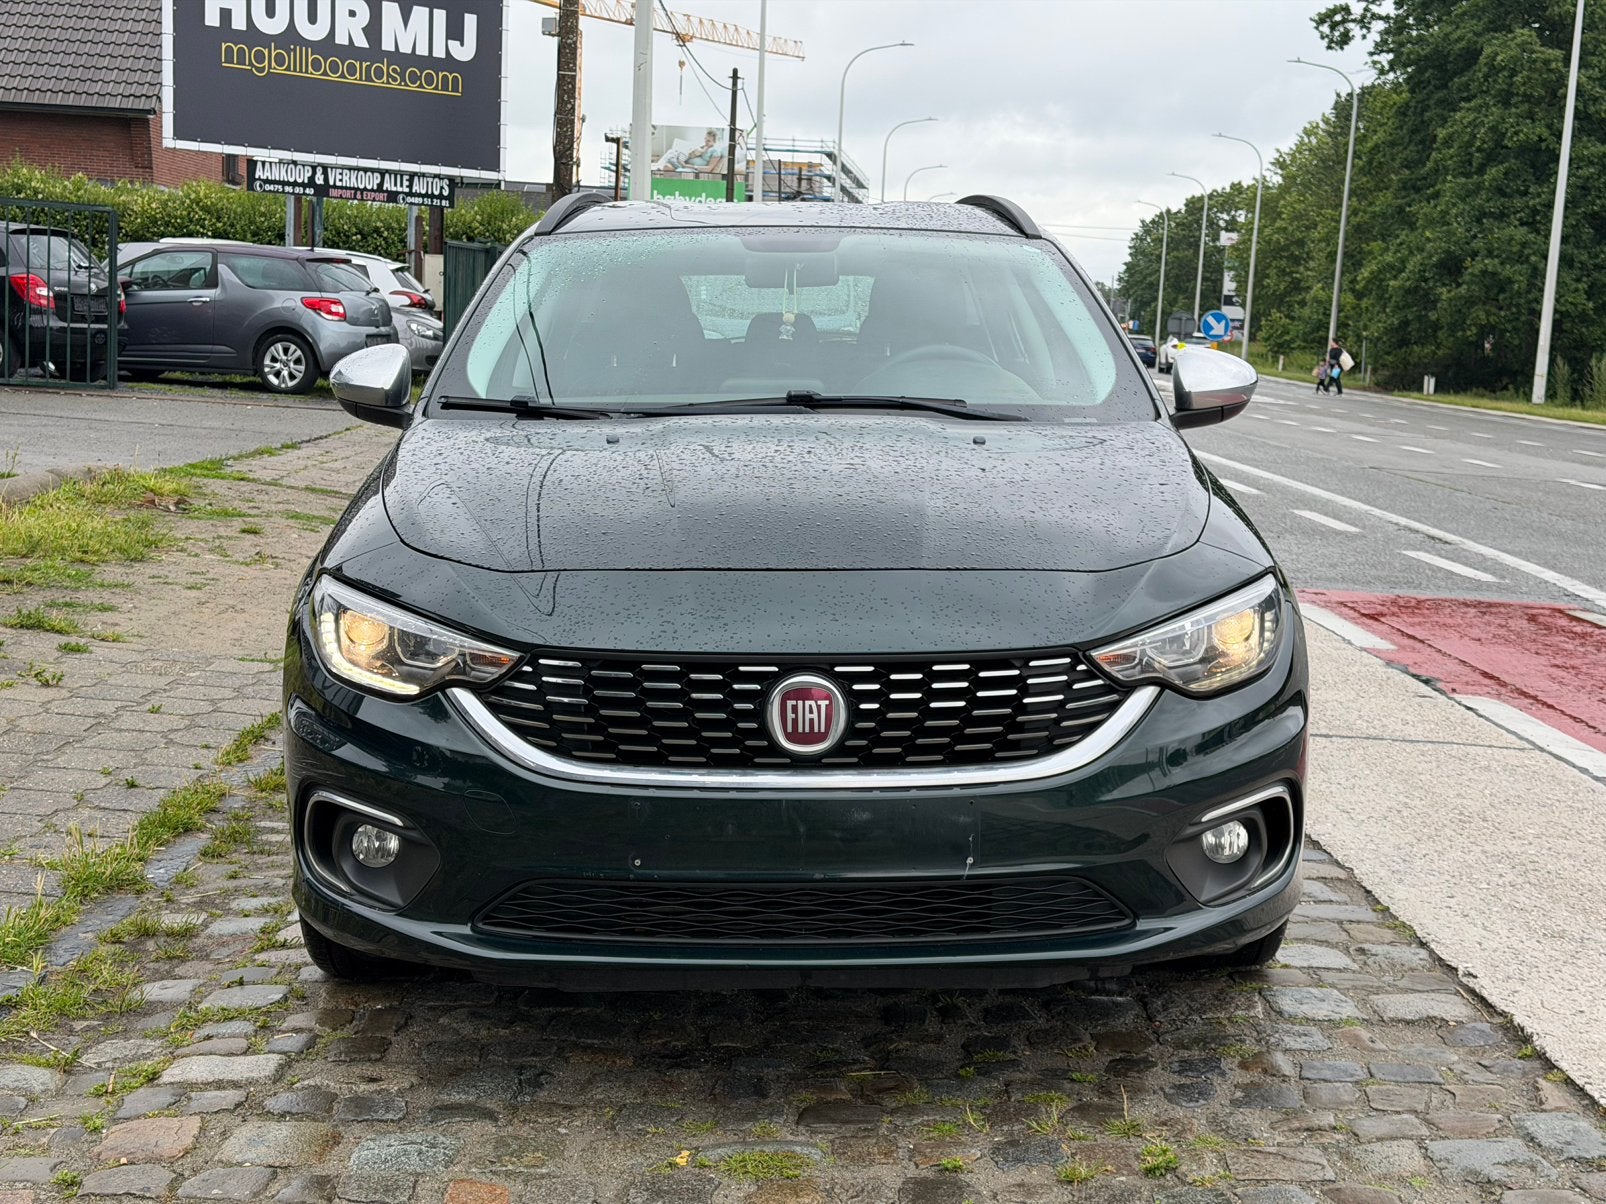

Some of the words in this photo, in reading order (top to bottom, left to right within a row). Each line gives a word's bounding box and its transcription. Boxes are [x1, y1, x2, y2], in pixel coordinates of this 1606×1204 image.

[204, 0, 370, 49] HUUR
[381, 0, 478, 62] MIJ
[221, 42, 462, 95] mgbillboards.com
[255, 161, 312, 183] AANKOOP
[315, 166, 324, 185] &
[327, 168, 381, 190] VERKOOP
[383, 173, 410, 192] ALLE
[412, 176, 449, 196] AUTO'S
[264, 184, 283, 192] 0475
[284, 185, 293, 193] 96
[329, 189, 355, 199] IMPORT
[363, 192, 388, 201] EXPORT
[786, 700, 830, 733] FIAT
